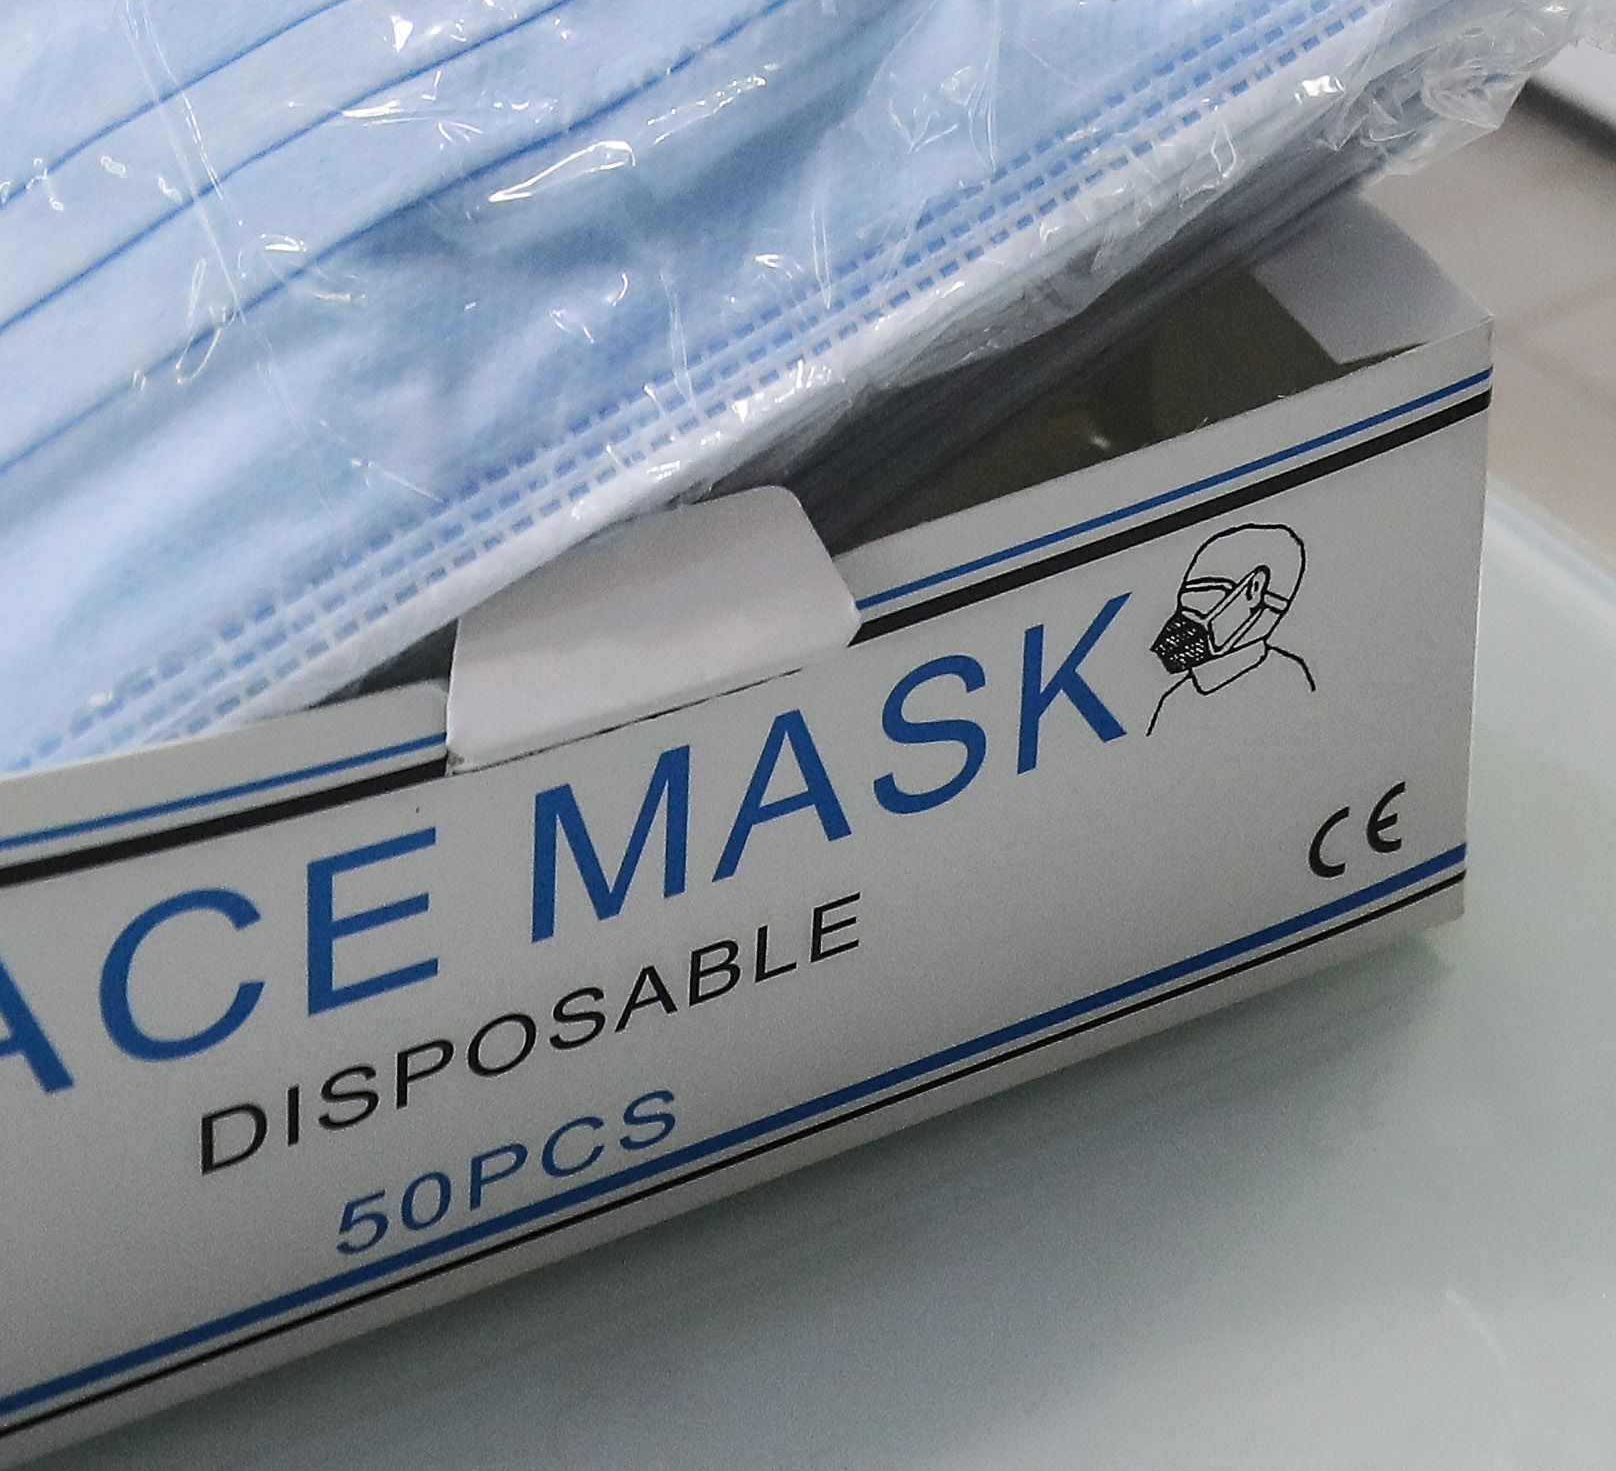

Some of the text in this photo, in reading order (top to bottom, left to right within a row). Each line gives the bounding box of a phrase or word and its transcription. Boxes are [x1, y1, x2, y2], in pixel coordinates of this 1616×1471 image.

[530, 590, 1134, 945] MASK
[199, 890, 862, 1178] DISPOSABLE
[337, 1090, 677, 1256] 50PCS
